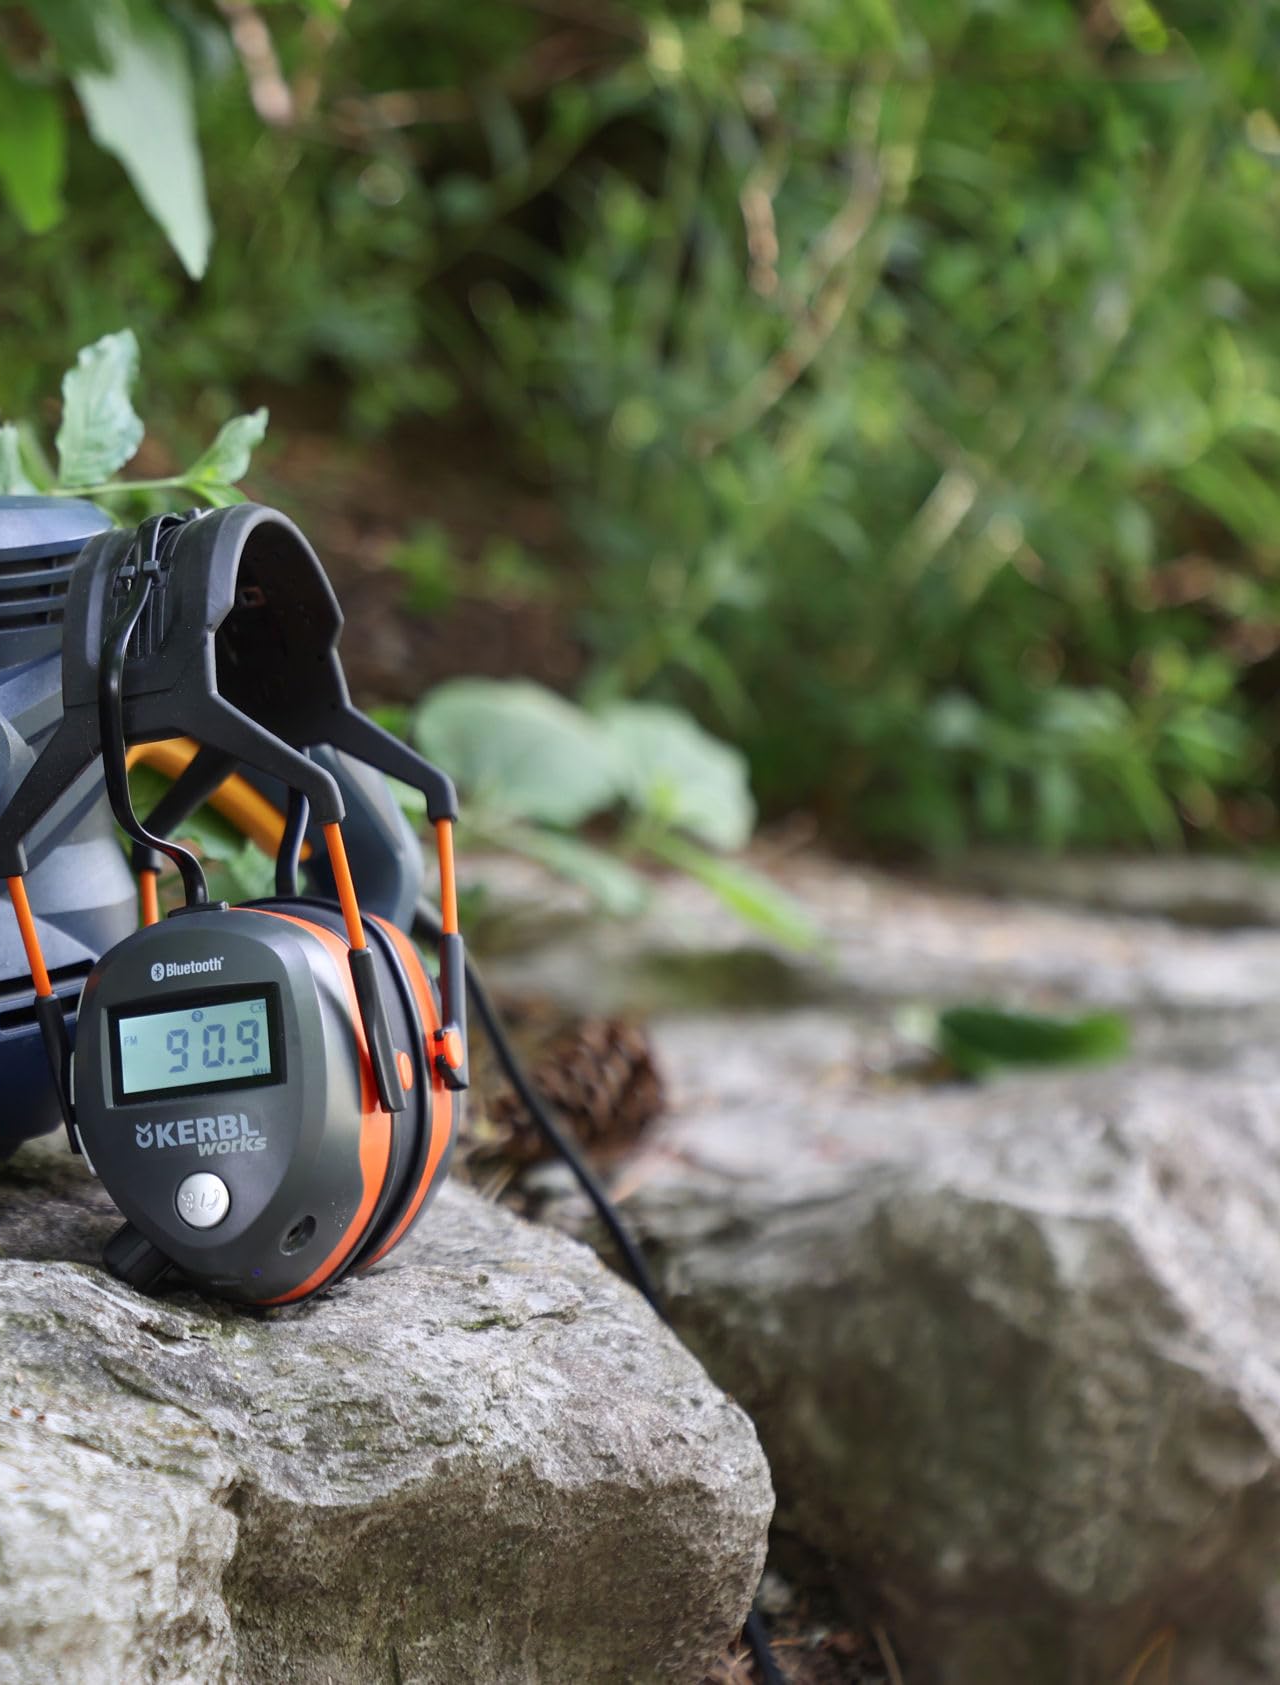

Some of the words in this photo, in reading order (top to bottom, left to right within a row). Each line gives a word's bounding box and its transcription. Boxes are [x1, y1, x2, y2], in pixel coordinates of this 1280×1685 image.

[124, 1034, 138, 1046] FM
[166, 1019, 259, 1073] 90.9
[155, 1113, 260, 1149] KERBL
[197, 1134, 268, 1157] works
